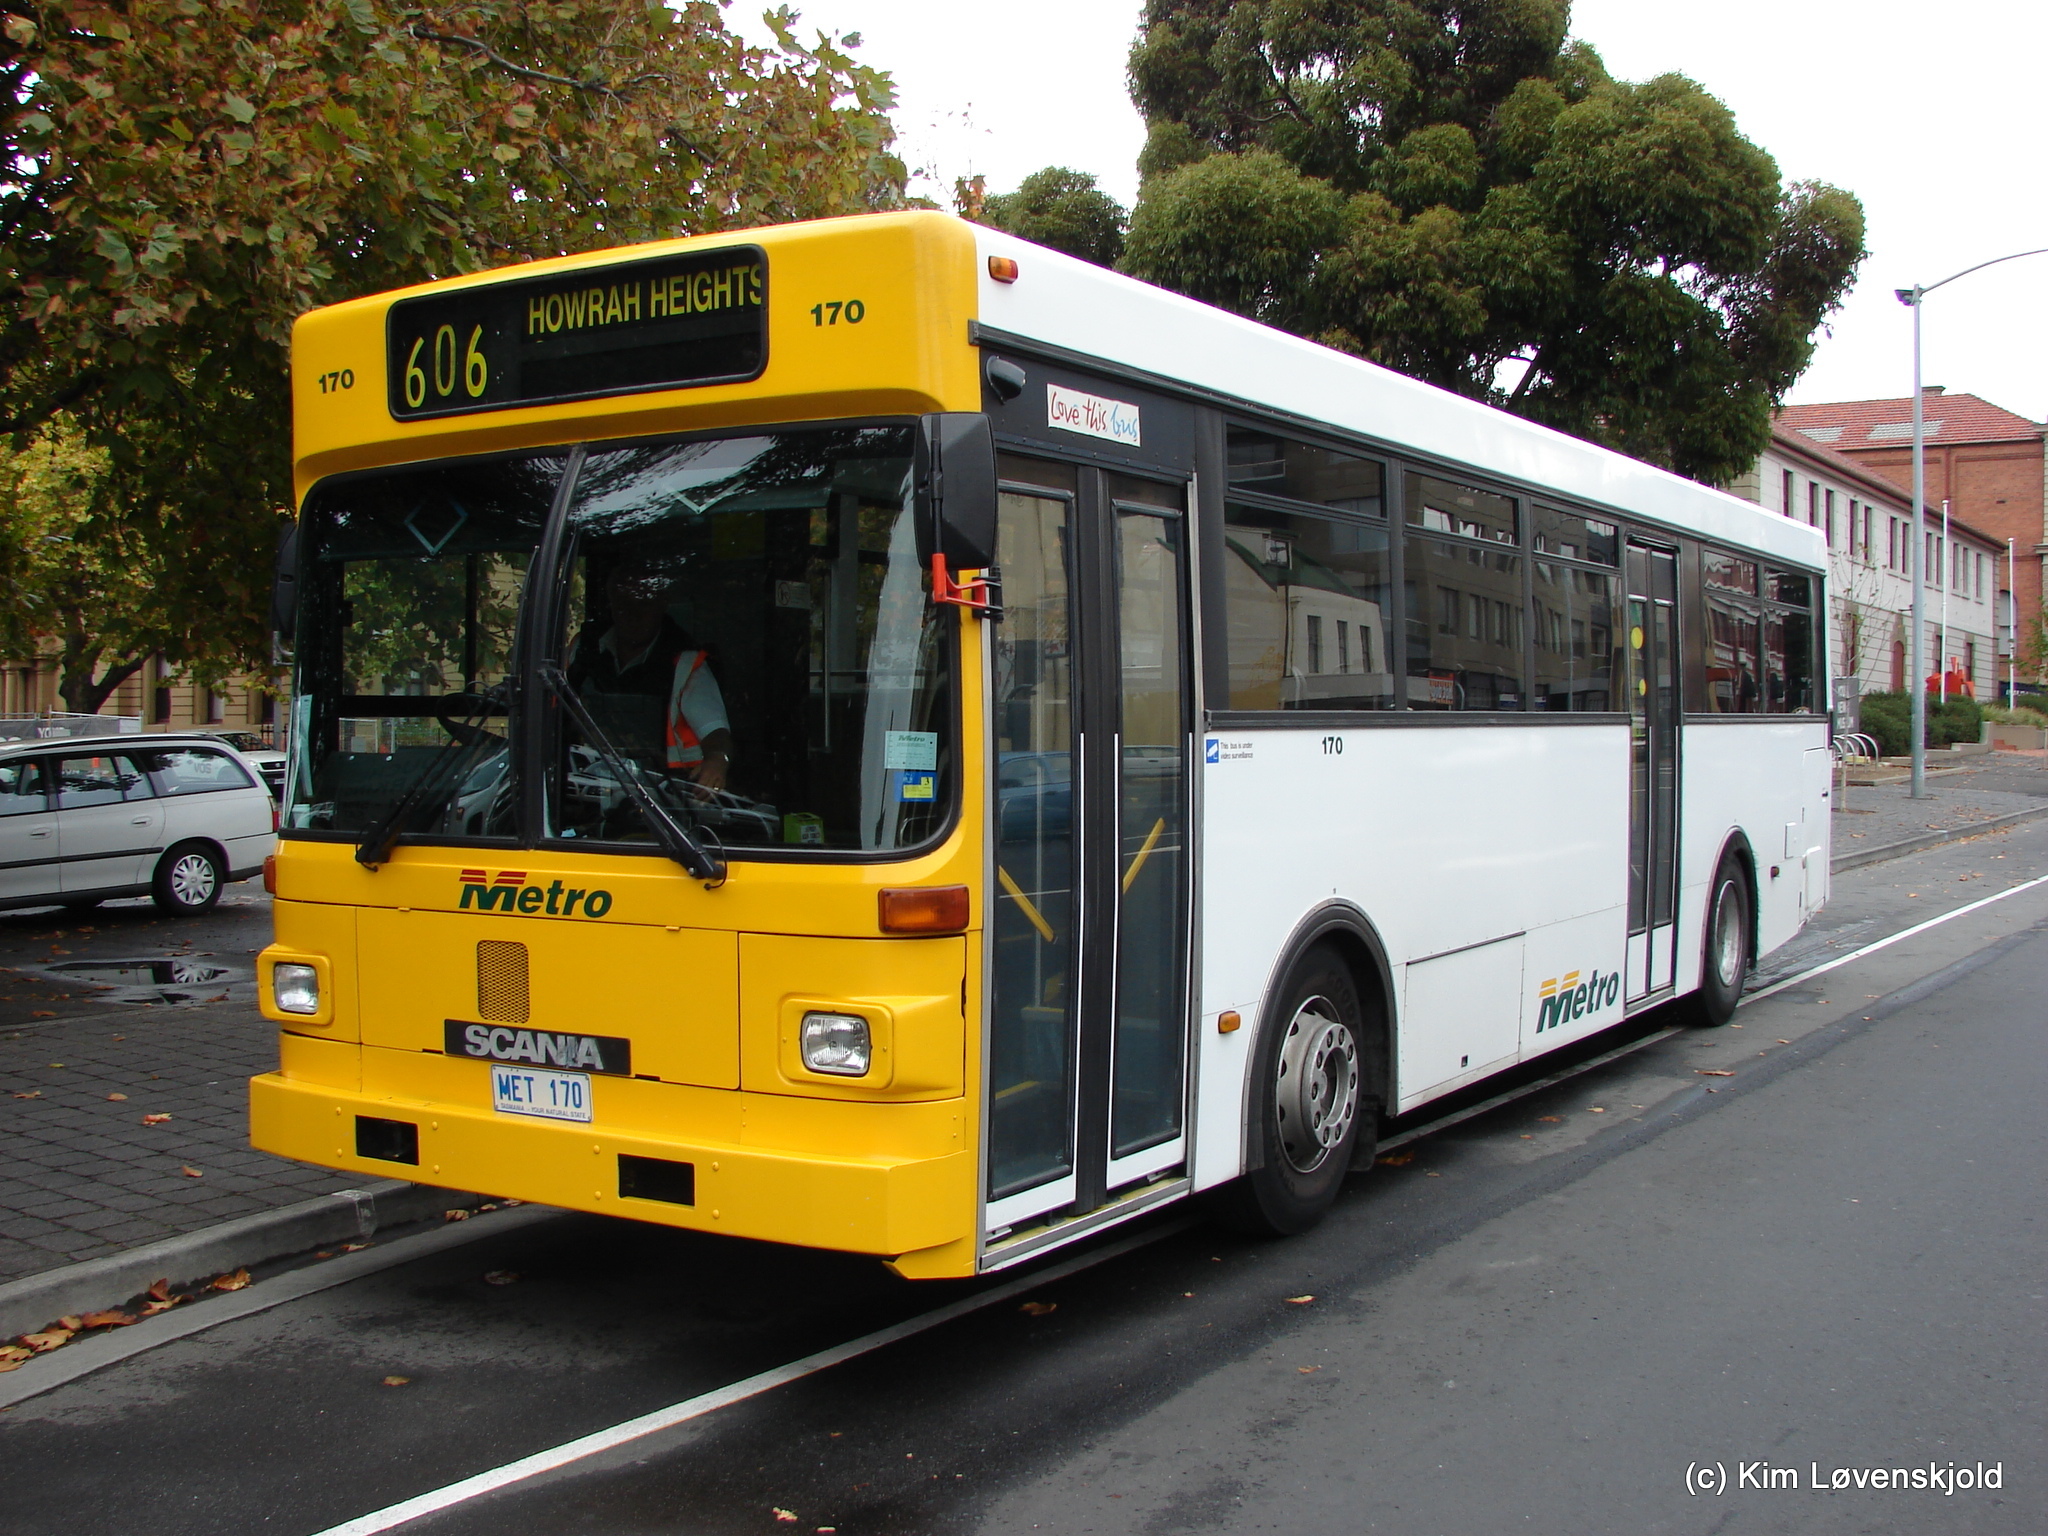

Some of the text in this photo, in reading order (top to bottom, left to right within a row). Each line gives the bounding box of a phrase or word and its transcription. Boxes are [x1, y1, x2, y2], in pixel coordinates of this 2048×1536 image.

[529, 263, 762, 335] HOWRAH HEIGHTS
[810, 299, 865, 327] 170
[318, 368, 355, 394] 170
[404, 323, 488, 408] 606
[1082, 398, 1107, 432] this
[1321, 736, 1344, 755] 170
[458, 869, 613, 919] Metro
[1535, 969, 1619, 1034] Metro
[465, 1024, 604, 1071] SCANIA
[498, 1074, 583, 1109] MET 170
[500, 1103, 525, 1112] TASMANIA
[546, 1109, 569, 1117] NATURAL
